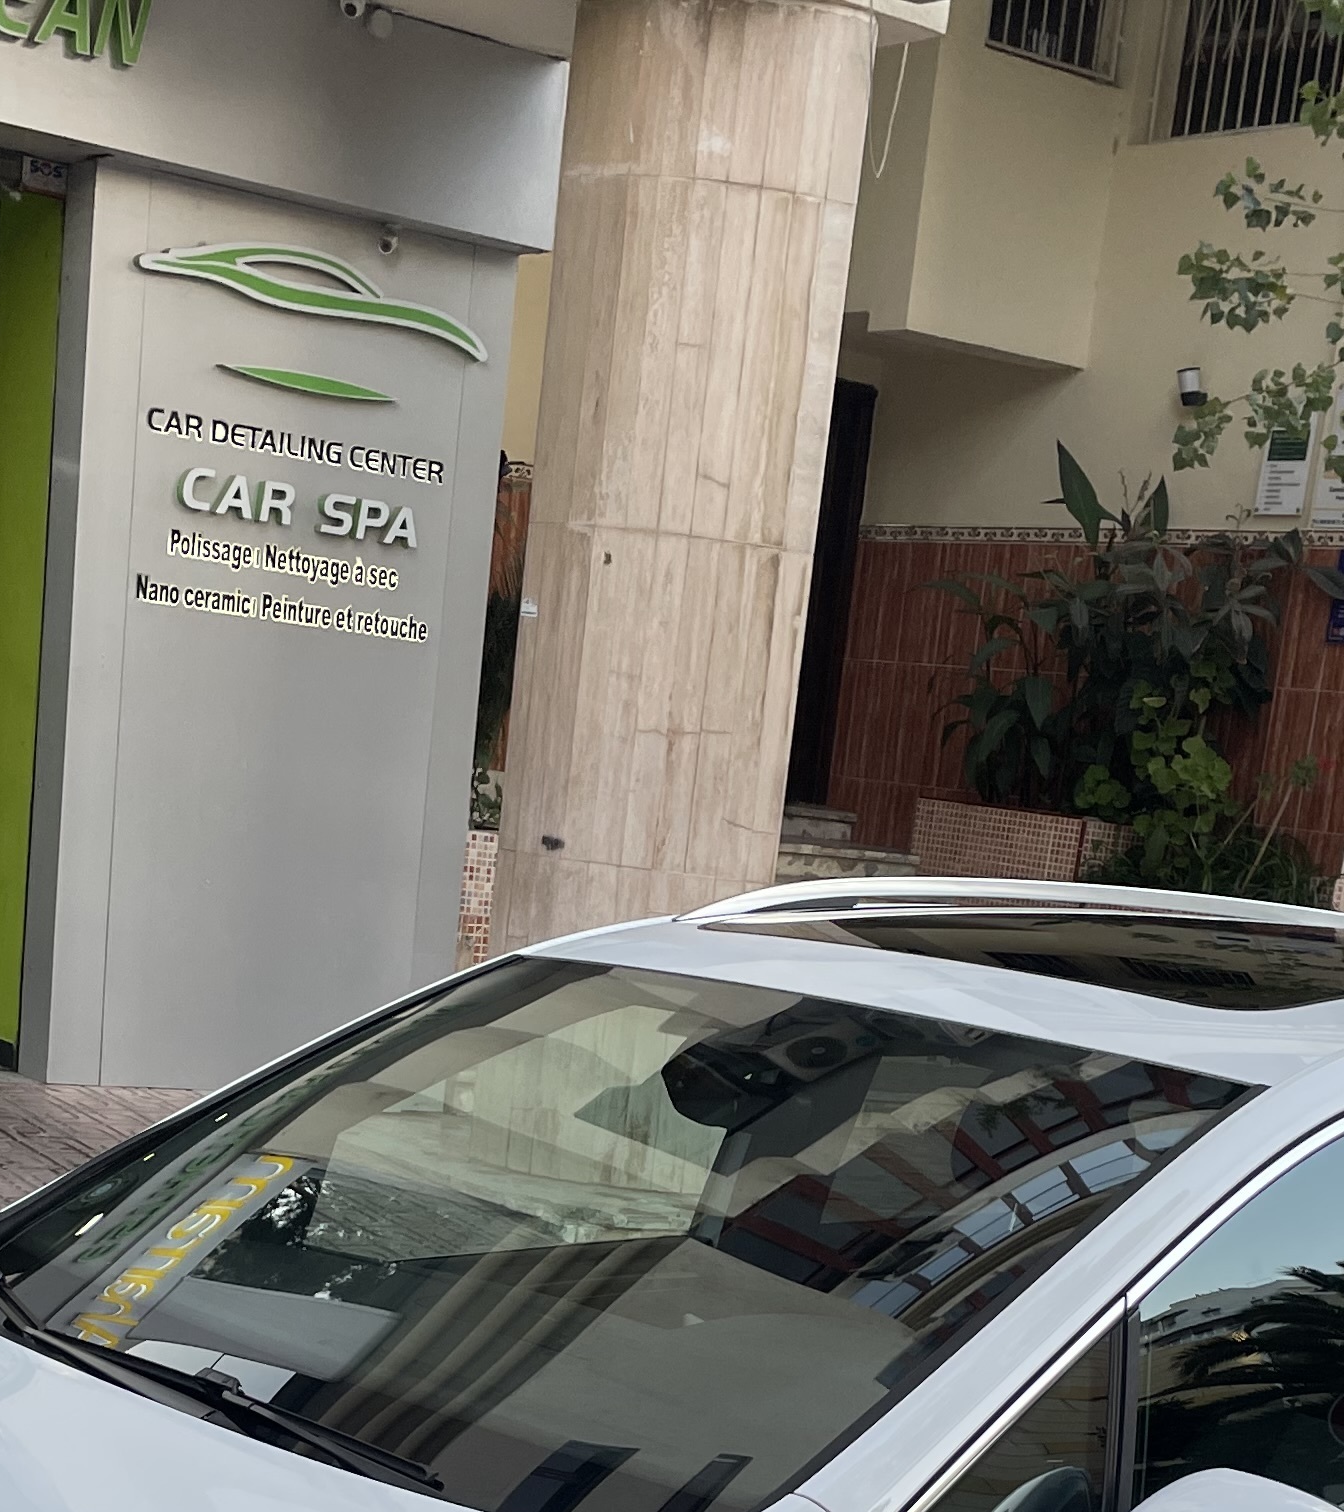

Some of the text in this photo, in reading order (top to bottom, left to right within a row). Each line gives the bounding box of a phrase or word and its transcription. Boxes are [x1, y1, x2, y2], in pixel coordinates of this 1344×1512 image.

[147, 407, 445, 484] CAR DETAILING CENTER
[178, 467, 418, 549] CAR SPA
[170, 529, 399, 591] Polissage Nettoyage à sec
[136, 573, 429, 642] Nano ceramic Peinture et retouche
